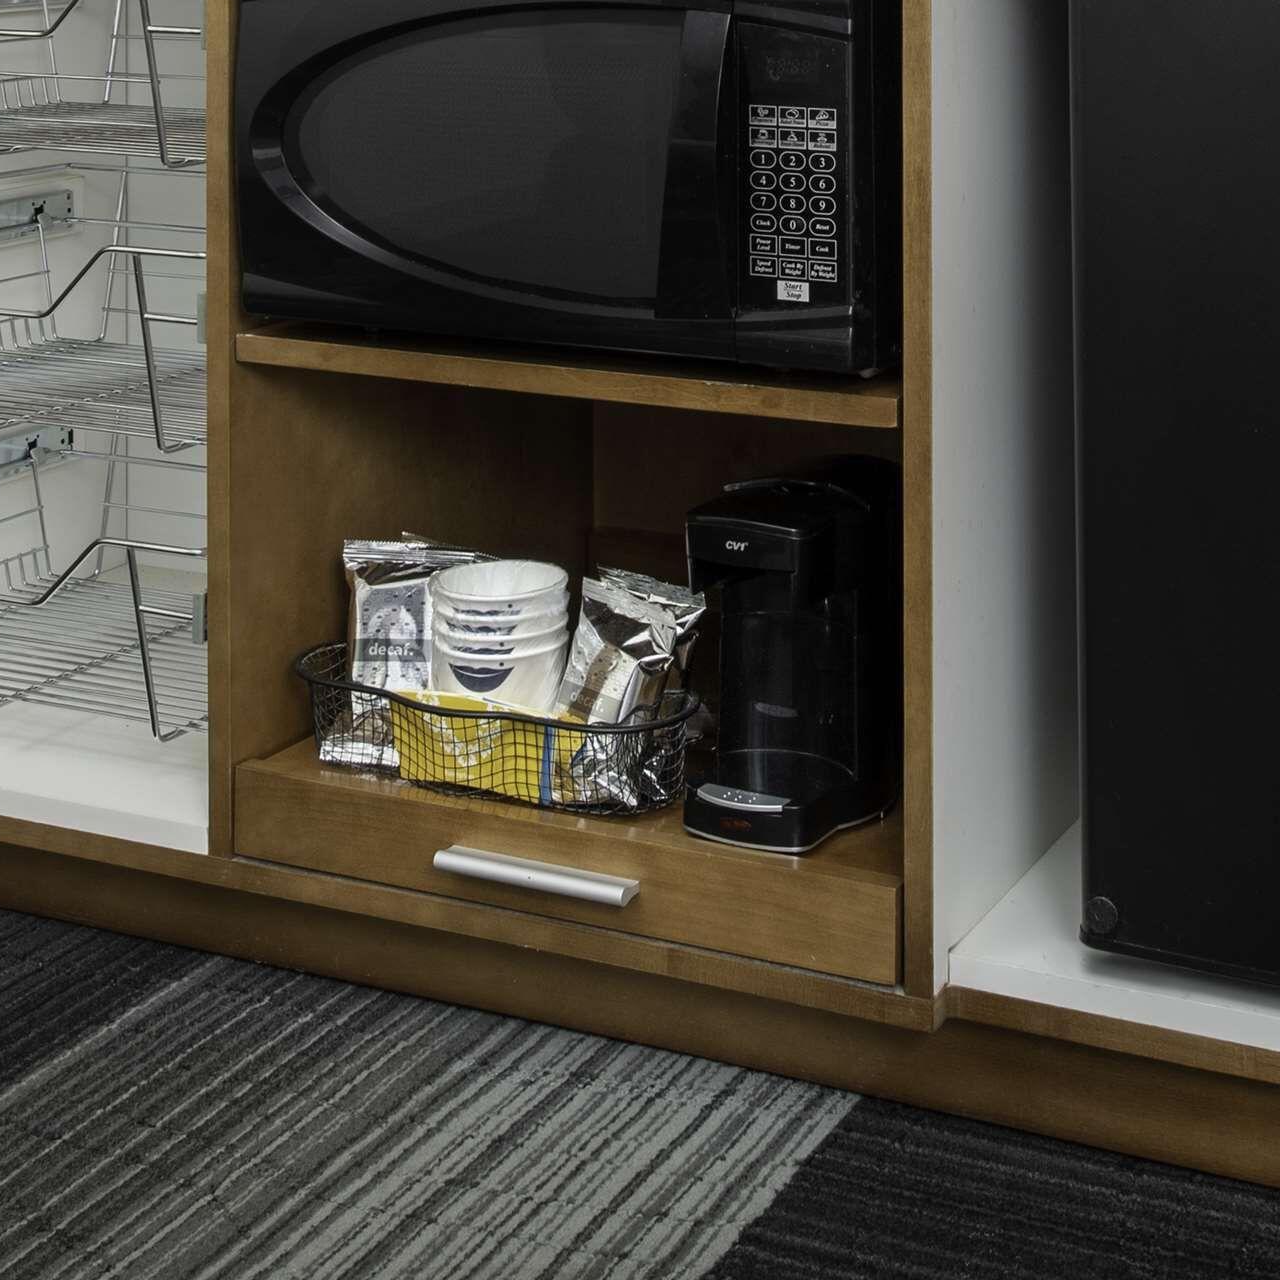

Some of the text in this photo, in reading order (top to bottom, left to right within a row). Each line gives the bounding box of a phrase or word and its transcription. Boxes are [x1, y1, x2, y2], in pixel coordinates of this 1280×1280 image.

[761, 154, 766, 164] 1
[789, 155, 796, 166] 2
[819, 157, 826, 168] 3
[759, 175, 766, 185] 4
[789, 177, 796, 187] 5
[819, 179, 826, 189] 6
[760, 196, 767, 207] 7
[789, 198, 796, 209] 8
[819, 200, 826, 211] 9
[789, 219, 796, 230] 0
[784, 282, 803, 290] Start
[785, 291, 802, 300] Stop
[369, 642, 414, 656] decaf.
